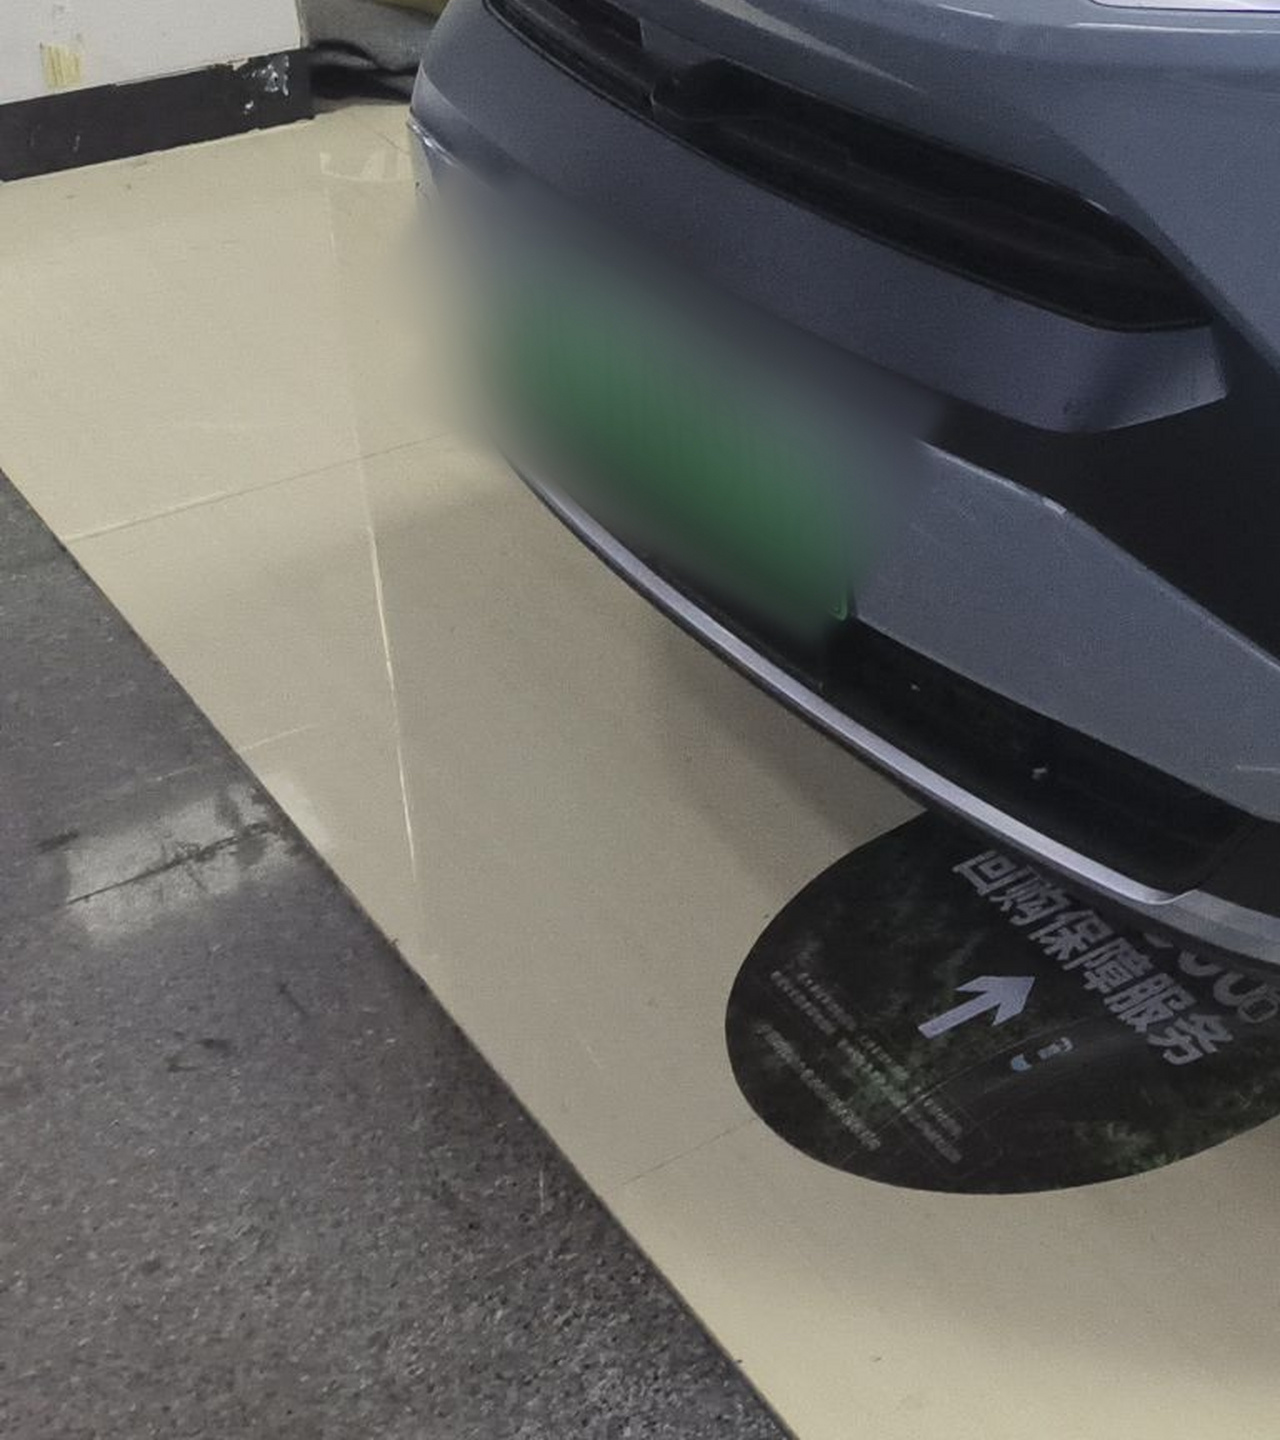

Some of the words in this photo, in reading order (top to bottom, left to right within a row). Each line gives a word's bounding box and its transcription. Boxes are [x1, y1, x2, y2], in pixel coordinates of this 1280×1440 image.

[951, 849, 1234, 1066] 回购保障服务
